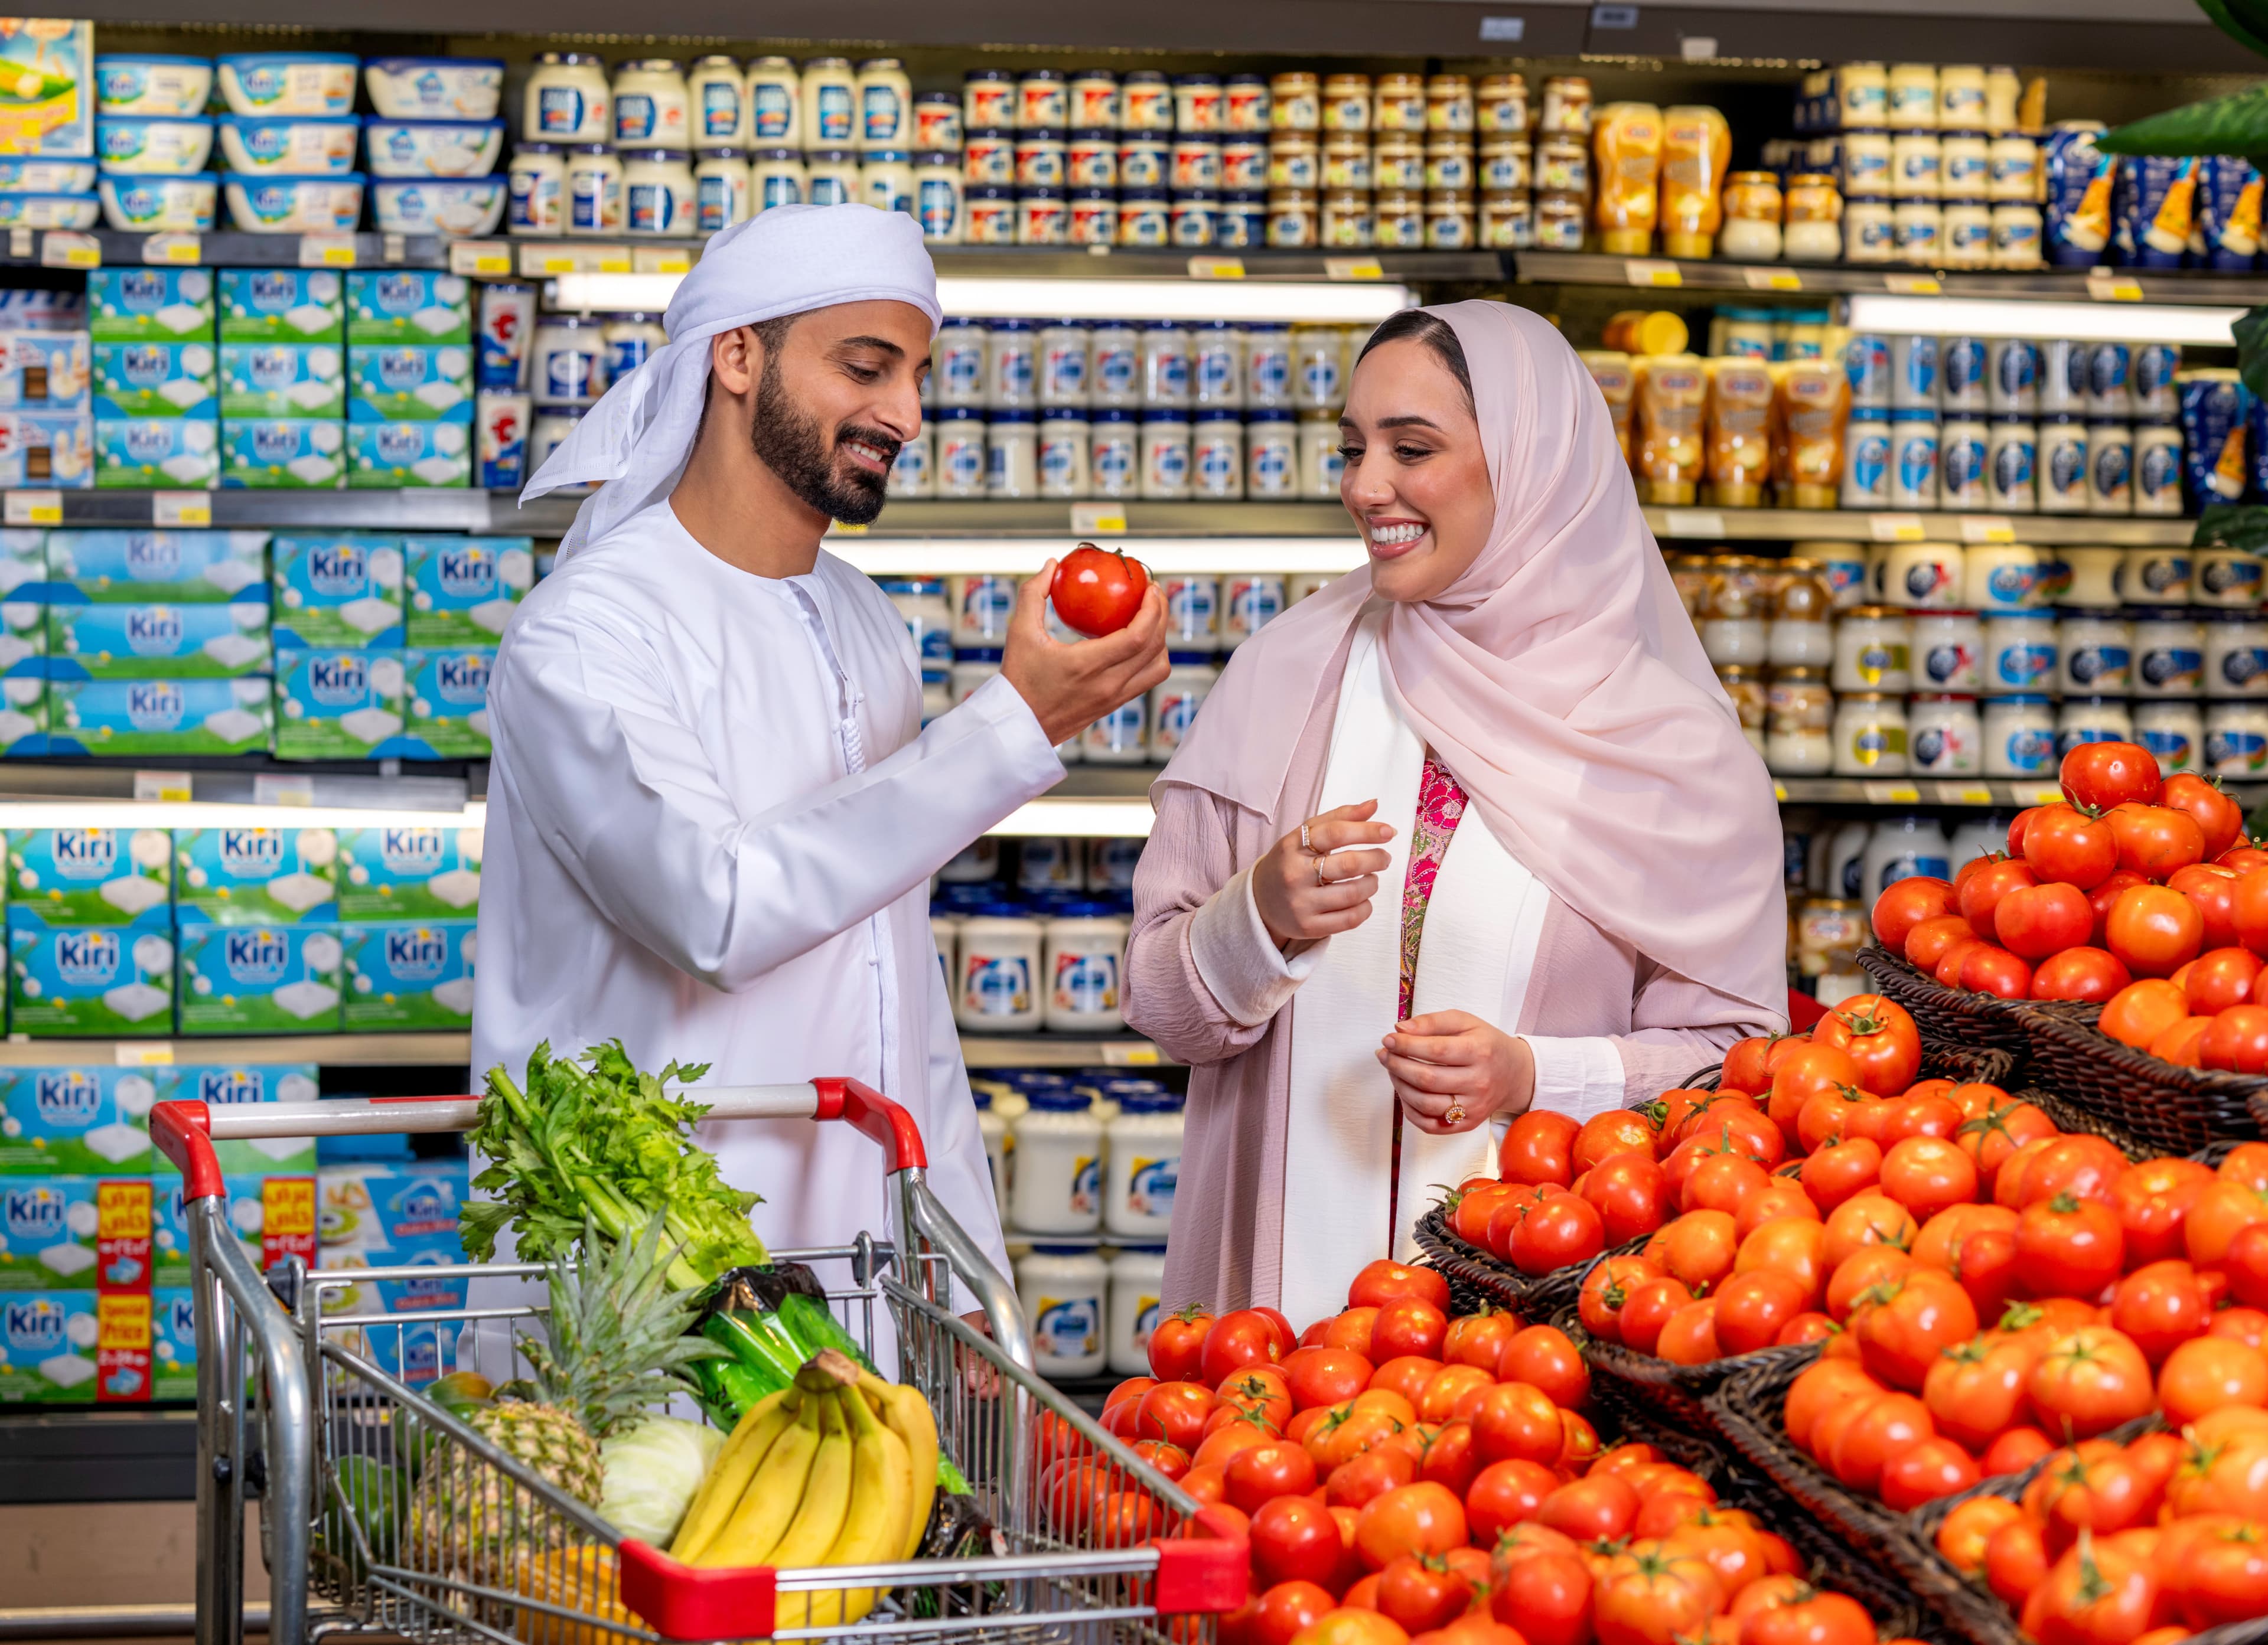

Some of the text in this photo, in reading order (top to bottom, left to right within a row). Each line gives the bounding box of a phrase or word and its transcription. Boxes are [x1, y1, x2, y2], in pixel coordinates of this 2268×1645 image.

[122, 276, 165, 296] Kiri
[253, 277, 295, 297] Kiri
[381, 279, 421, 299] Kiri
[126, 351, 168, 371] Kiri
[253, 352, 295, 373] Kiri
[383, 354, 424, 374] Kiri
[128, 426, 171, 446] Kiri
[256, 427, 298, 448] Kiri
[381, 429, 421, 449] Kiri
[130, 536, 177, 562] Kiri
[314, 552, 361, 577] Kiri
[444, 554, 491, 579] Kiri
[131, 612, 178, 637] Kiri
[314, 662, 362, 687] Kiri
[442, 661, 490, 686] Kiri
[132, 686, 179, 711] Kiri
[59, 830, 111, 858] Kiri
[226, 828, 278, 856] Kiri
[387, 828, 438, 853] Kiri
[61, 938, 115, 966] Kiri
[232, 936, 284, 964] Kiri
[391, 934, 442, 962] Kiri
[41, 1078, 96, 1106] Kiri
[206, 1076, 259, 1103] Kiri
[9, 1196, 61, 1221] Kiri
[407, 1200, 441, 1216] Kiri
[10, 1307, 60, 1333] Kiri
[103, 1322, 143, 1339] Price
